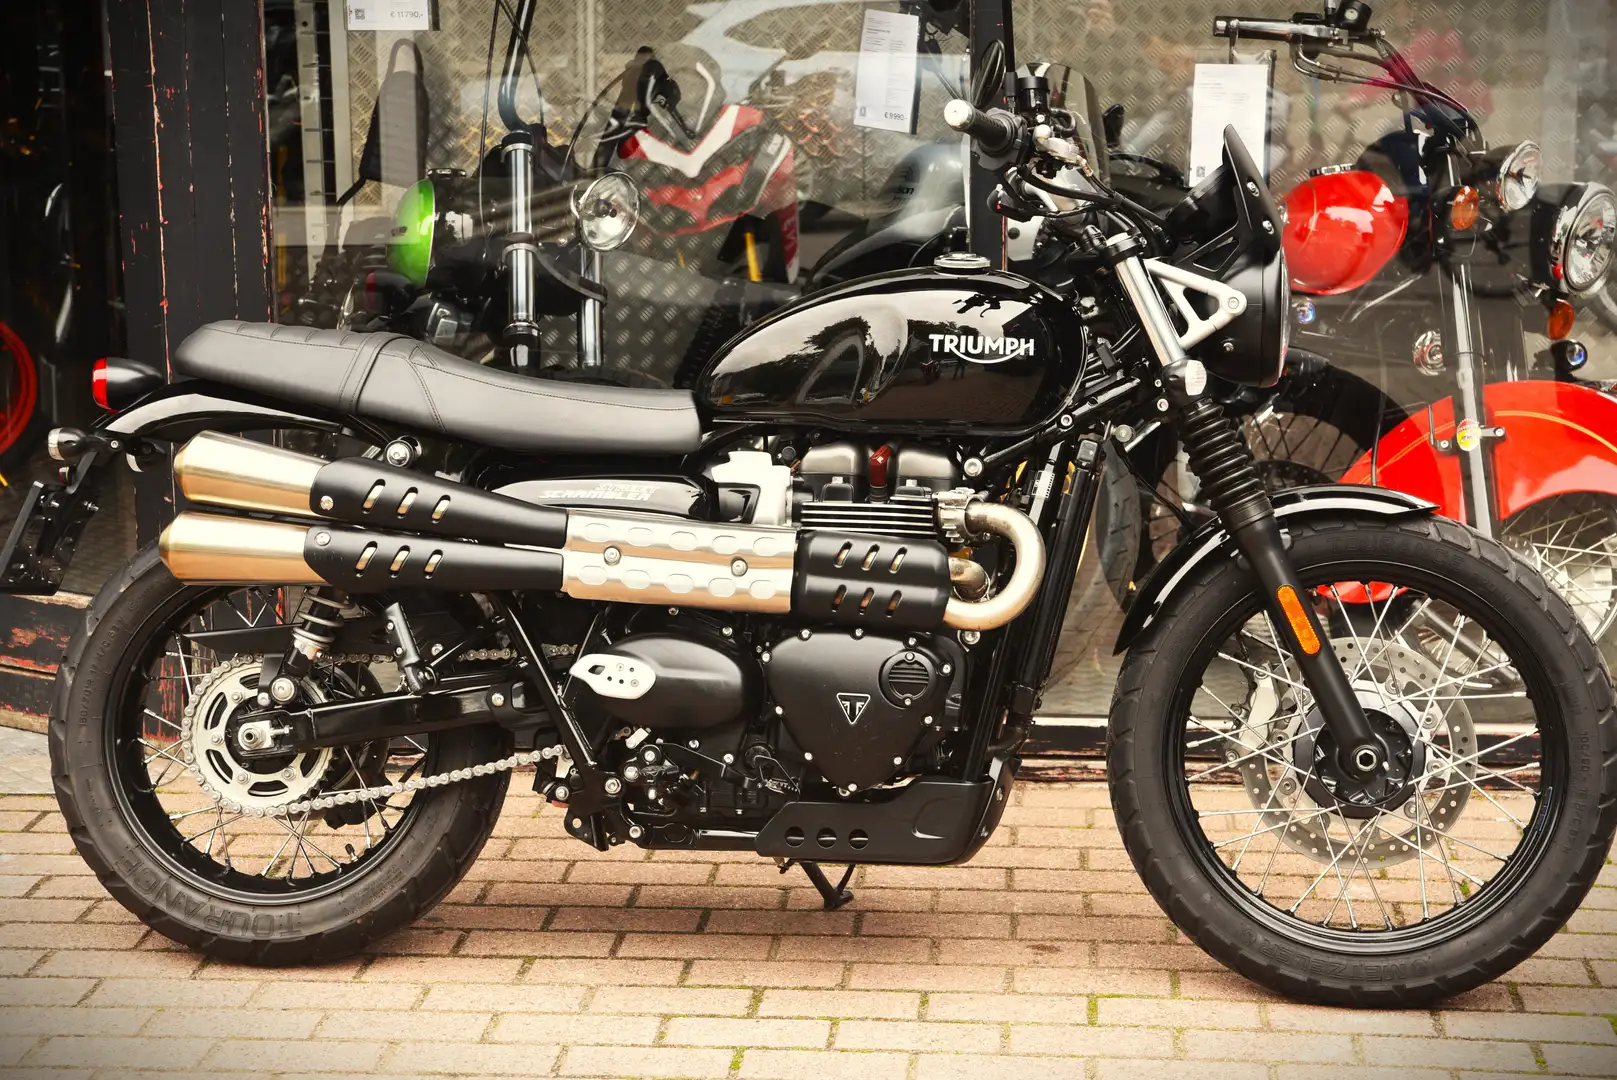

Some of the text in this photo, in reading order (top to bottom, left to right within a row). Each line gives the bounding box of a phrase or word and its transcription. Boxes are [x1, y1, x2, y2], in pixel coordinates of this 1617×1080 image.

[928, 333, 1035, 364] TRIUMPH
[538, 489, 651, 501] SCRAMBLER
[596, 482, 660, 494] STREET
[1325, 534, 1465, 572] TOURANCE
[114, 849, 302, 938] TOURANCE
[1260, 938, 1408, 982] METZELER
